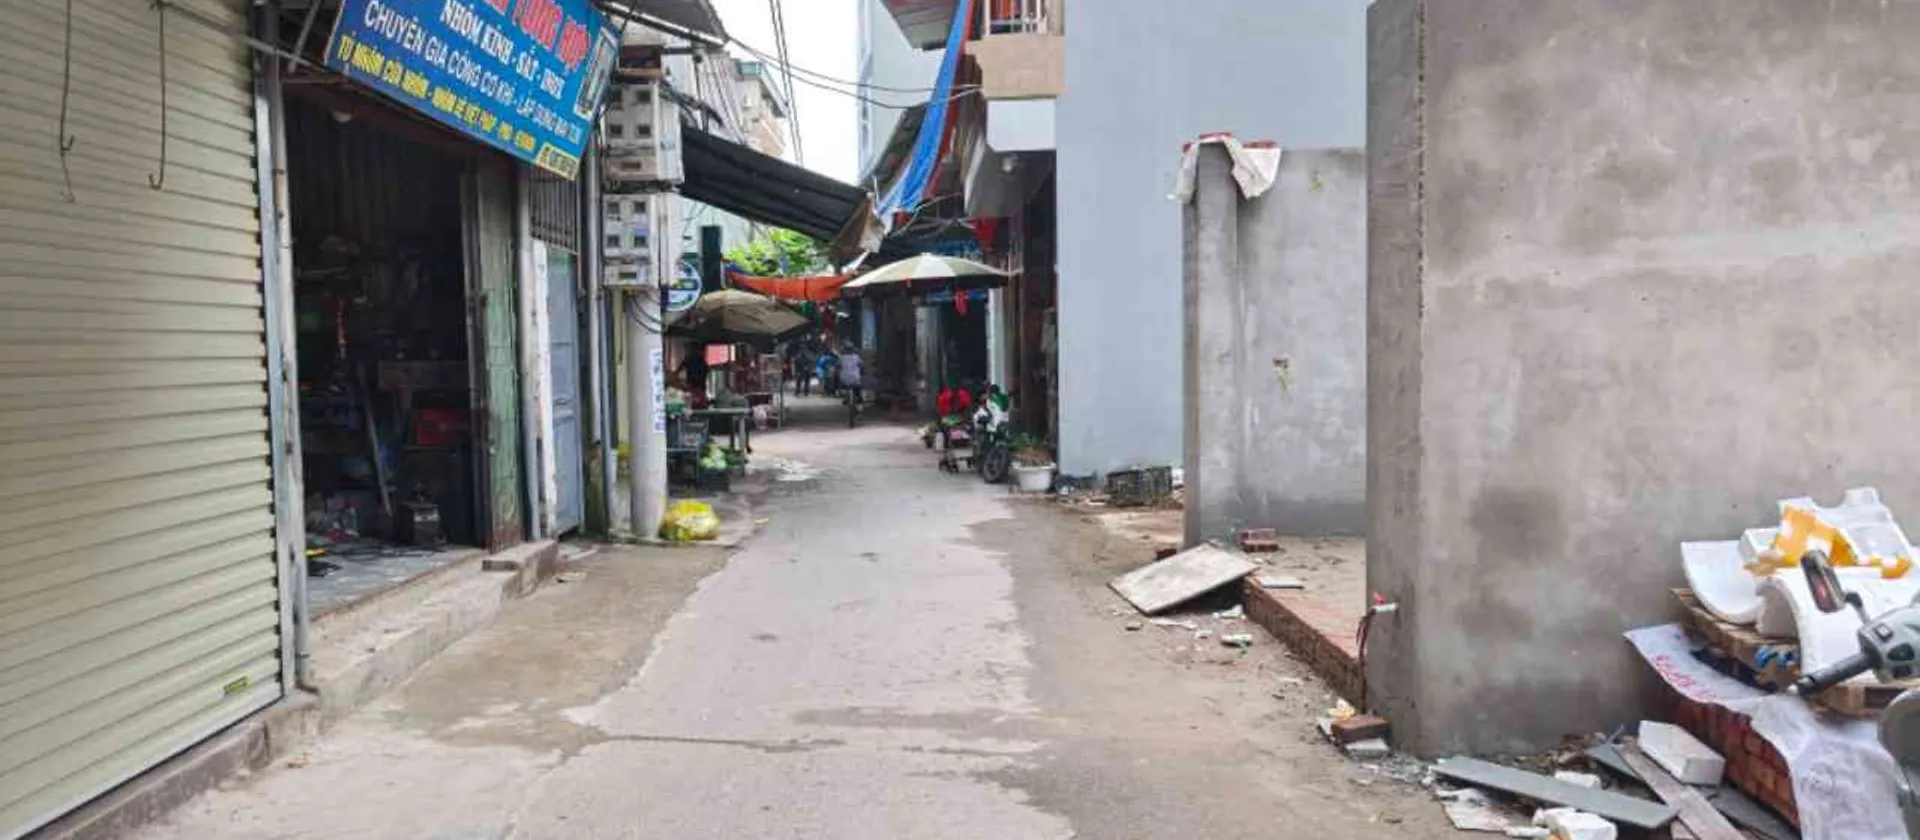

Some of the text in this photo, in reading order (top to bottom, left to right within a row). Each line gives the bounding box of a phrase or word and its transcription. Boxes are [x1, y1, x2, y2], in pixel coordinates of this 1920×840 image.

[365, 0, 426, 54] CHUYÊN
[425, 36, 448, 69] GIA
[447, 50, 481, 87] CÔNG
